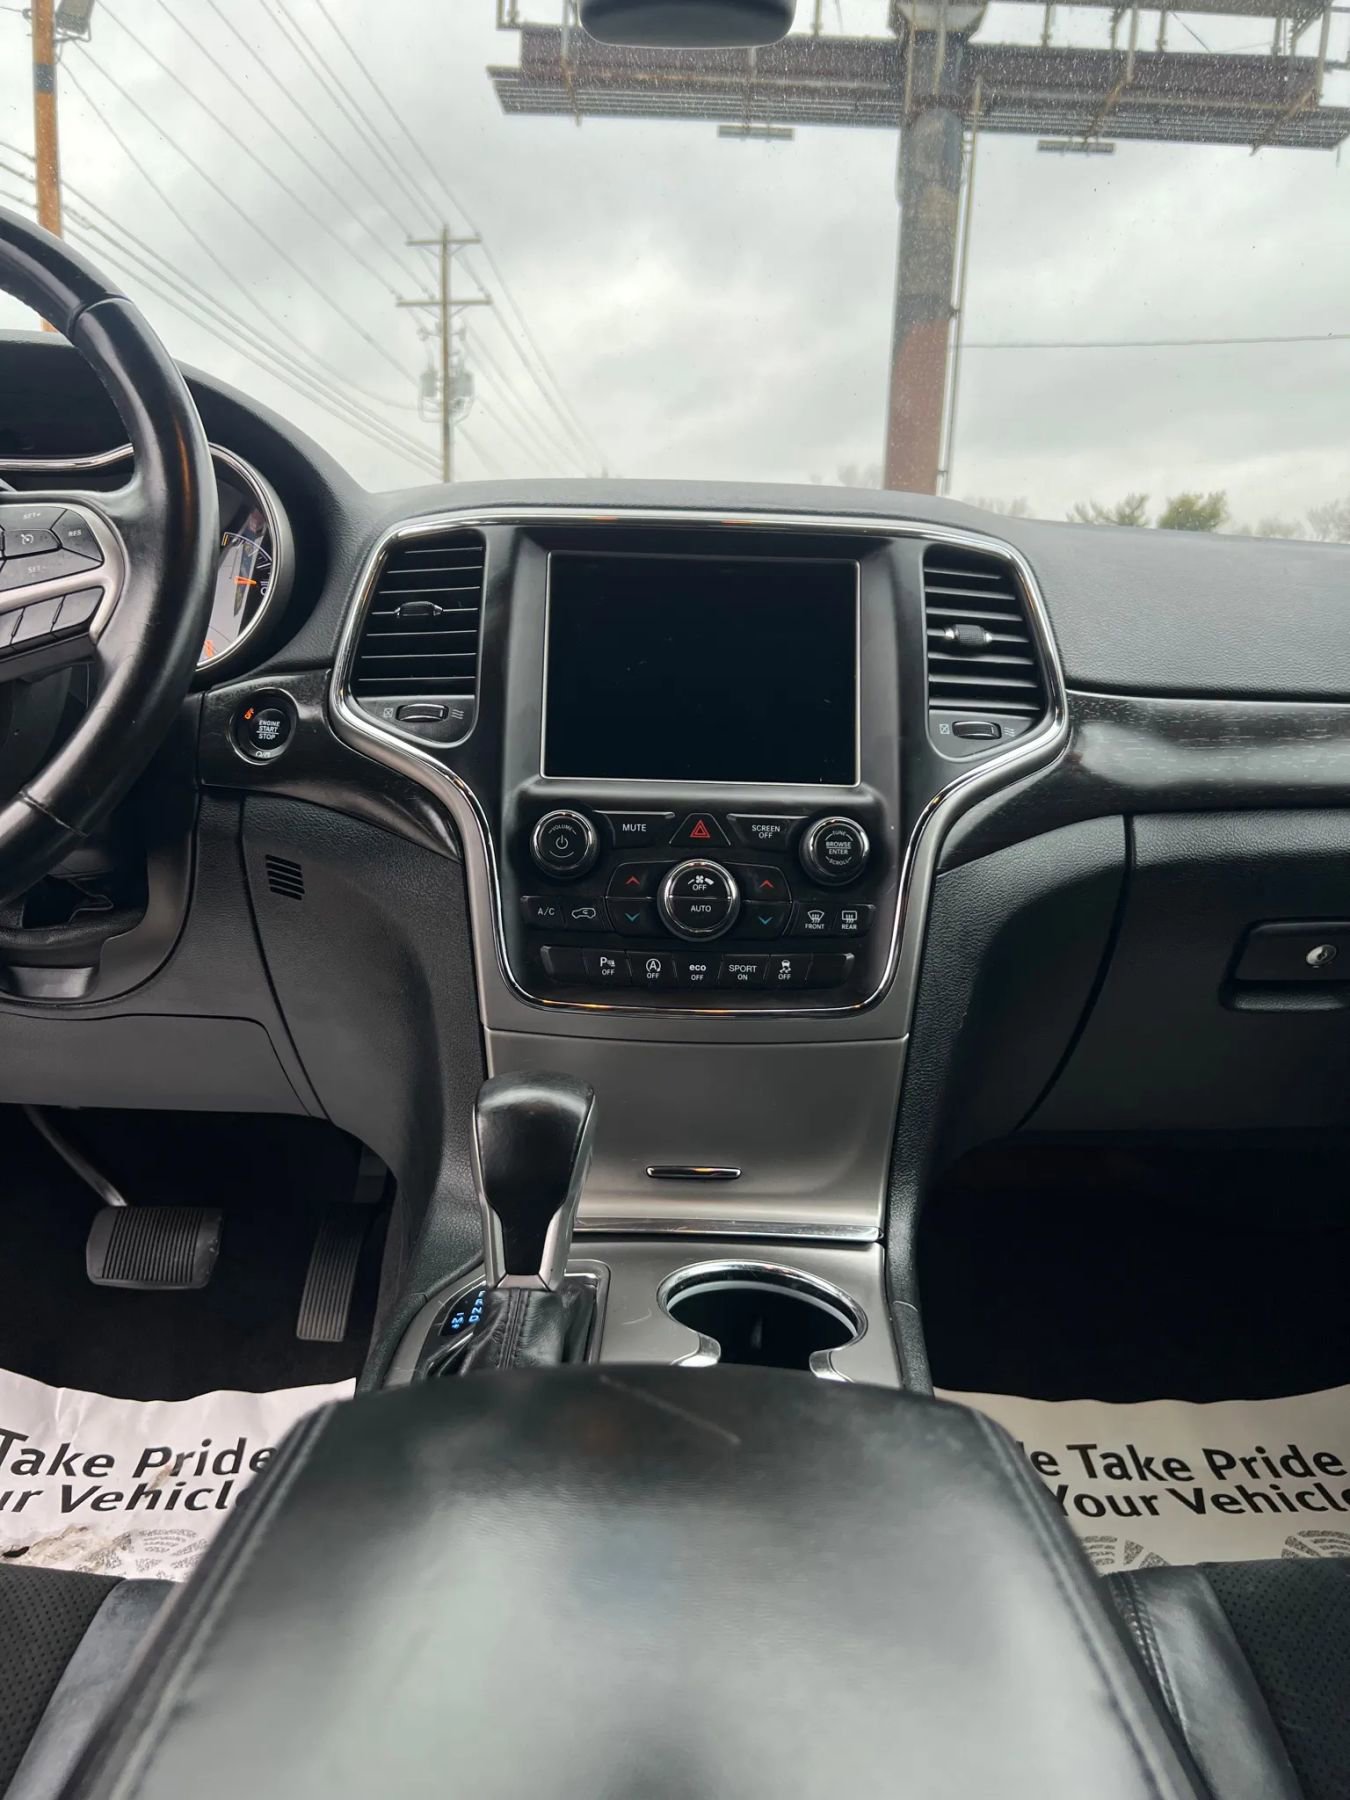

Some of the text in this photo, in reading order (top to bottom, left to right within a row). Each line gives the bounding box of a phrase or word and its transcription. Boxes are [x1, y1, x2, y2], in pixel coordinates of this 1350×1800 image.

[67, 529, 82, 537] RES
[258, 725, 279, 733] START
[622, 823, 647, 832] MUTE
[751, 824, 781, 833] SCREEN
[828, 858, 849, 866] SCROLL
[692, 883, 708, 891] OFF
[537, 906, 556, 916] A/C
[690, 904, 712, 912] AUTO
[601, 968, 616, 976] OFF
[689, 963, 707, 972] eco
[728, 964, 758, 973] SPORT
[737, 973, 749, 981] ON
[132, 1436, 278, 1478] Pride
[1015, 1440, 1348, 1482] e Take Pride
[60, 1479, 246, 1514] Vehicl
